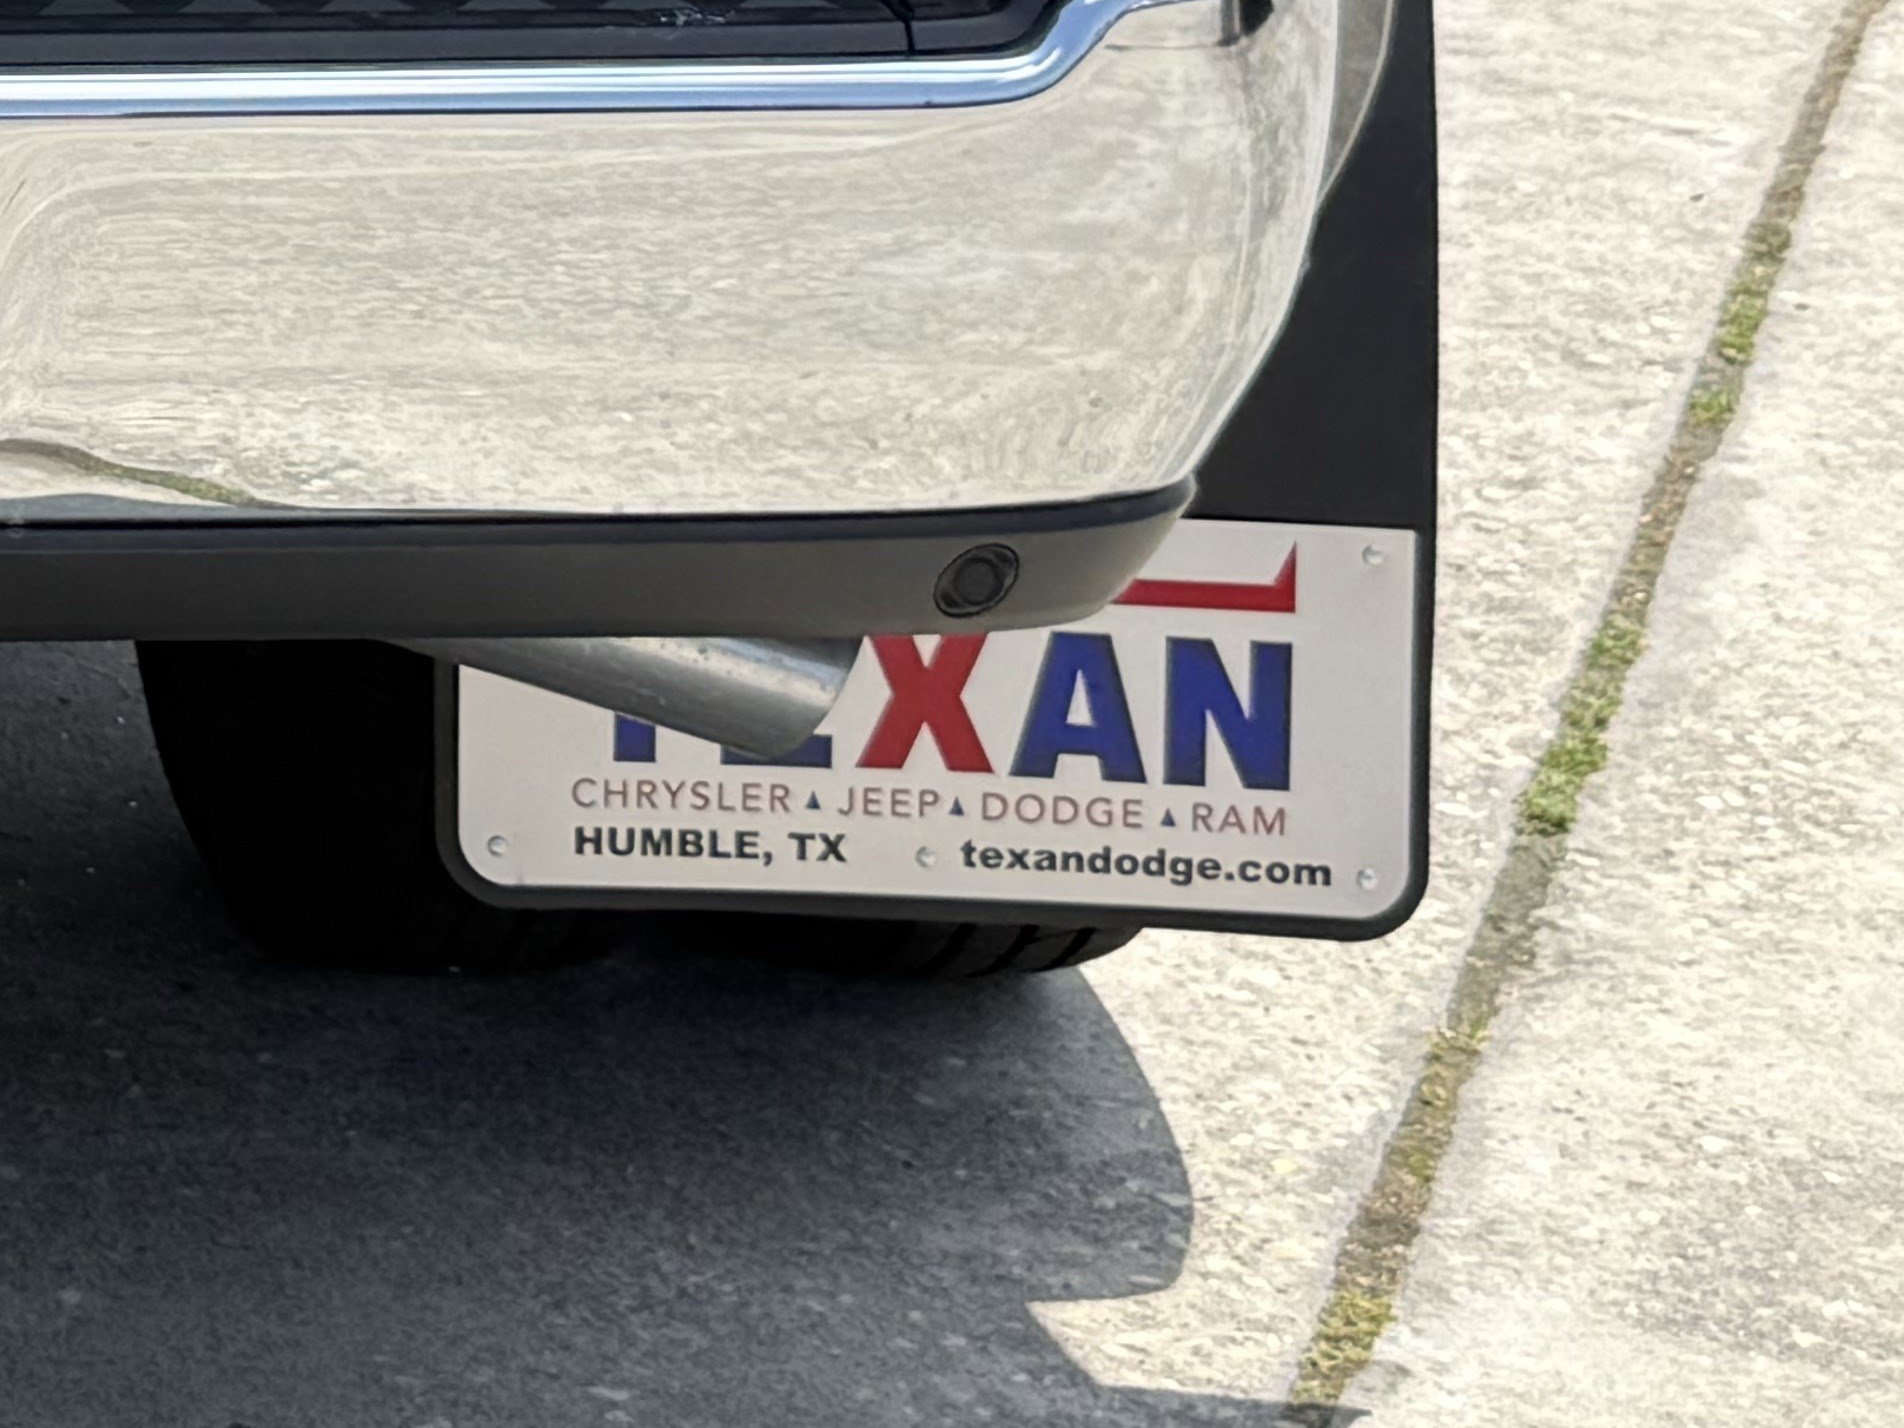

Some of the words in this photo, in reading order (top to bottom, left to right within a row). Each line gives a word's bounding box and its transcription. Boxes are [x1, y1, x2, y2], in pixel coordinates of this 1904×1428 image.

[570, 777, 792, 814] CHRYSLER
[837, 787, 941, 818] JEEP
[980, 792, 1144, 829] DODGE
[1192, 801, 1287, 836] RAM
[574, 826, 774, 867] HUMBLE,
[787, 831, 848, 863] TX
[959, 838, 1332, 887] texandodge.com
